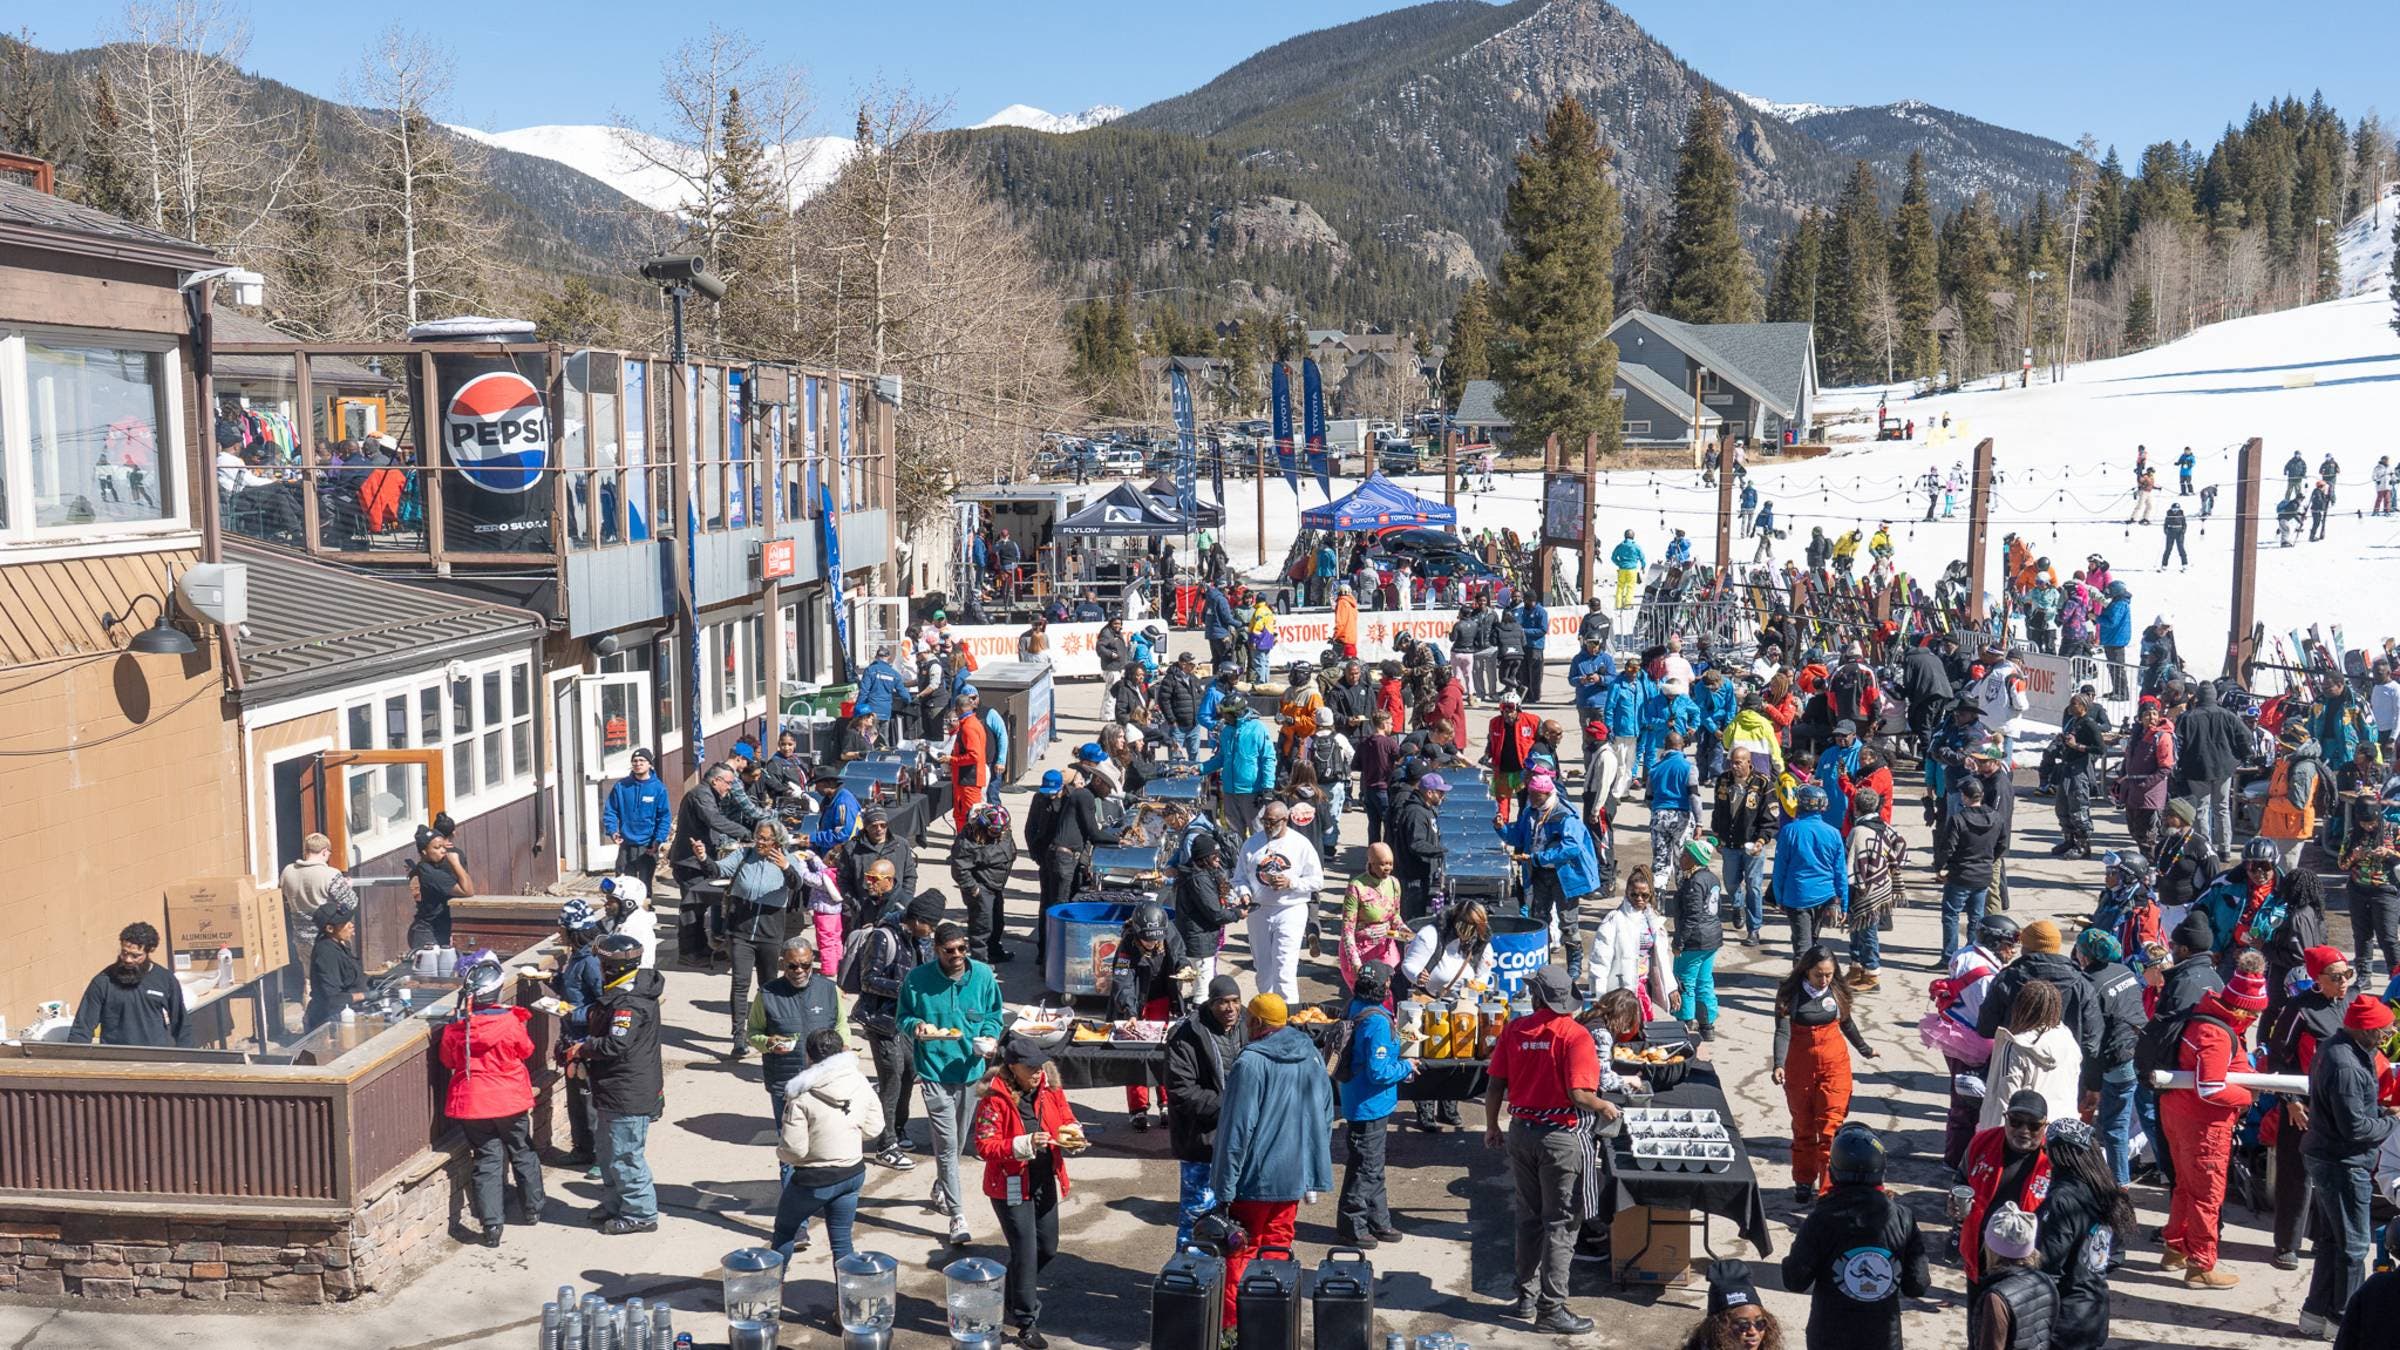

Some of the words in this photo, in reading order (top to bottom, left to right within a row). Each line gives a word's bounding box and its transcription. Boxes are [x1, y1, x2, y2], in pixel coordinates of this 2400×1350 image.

[1281, 395, 1289, 435] TOYOTA
[451, 419, 546, 448] PEPSI
[473, 523, 509, 533] ZERO
[510, 520, 549, 531] SUGAR
[2023, 666, 2056, 695] STONE
[181, 932, 218, 941] ALUMINUM
[219, 931, 233, 940] CUP
